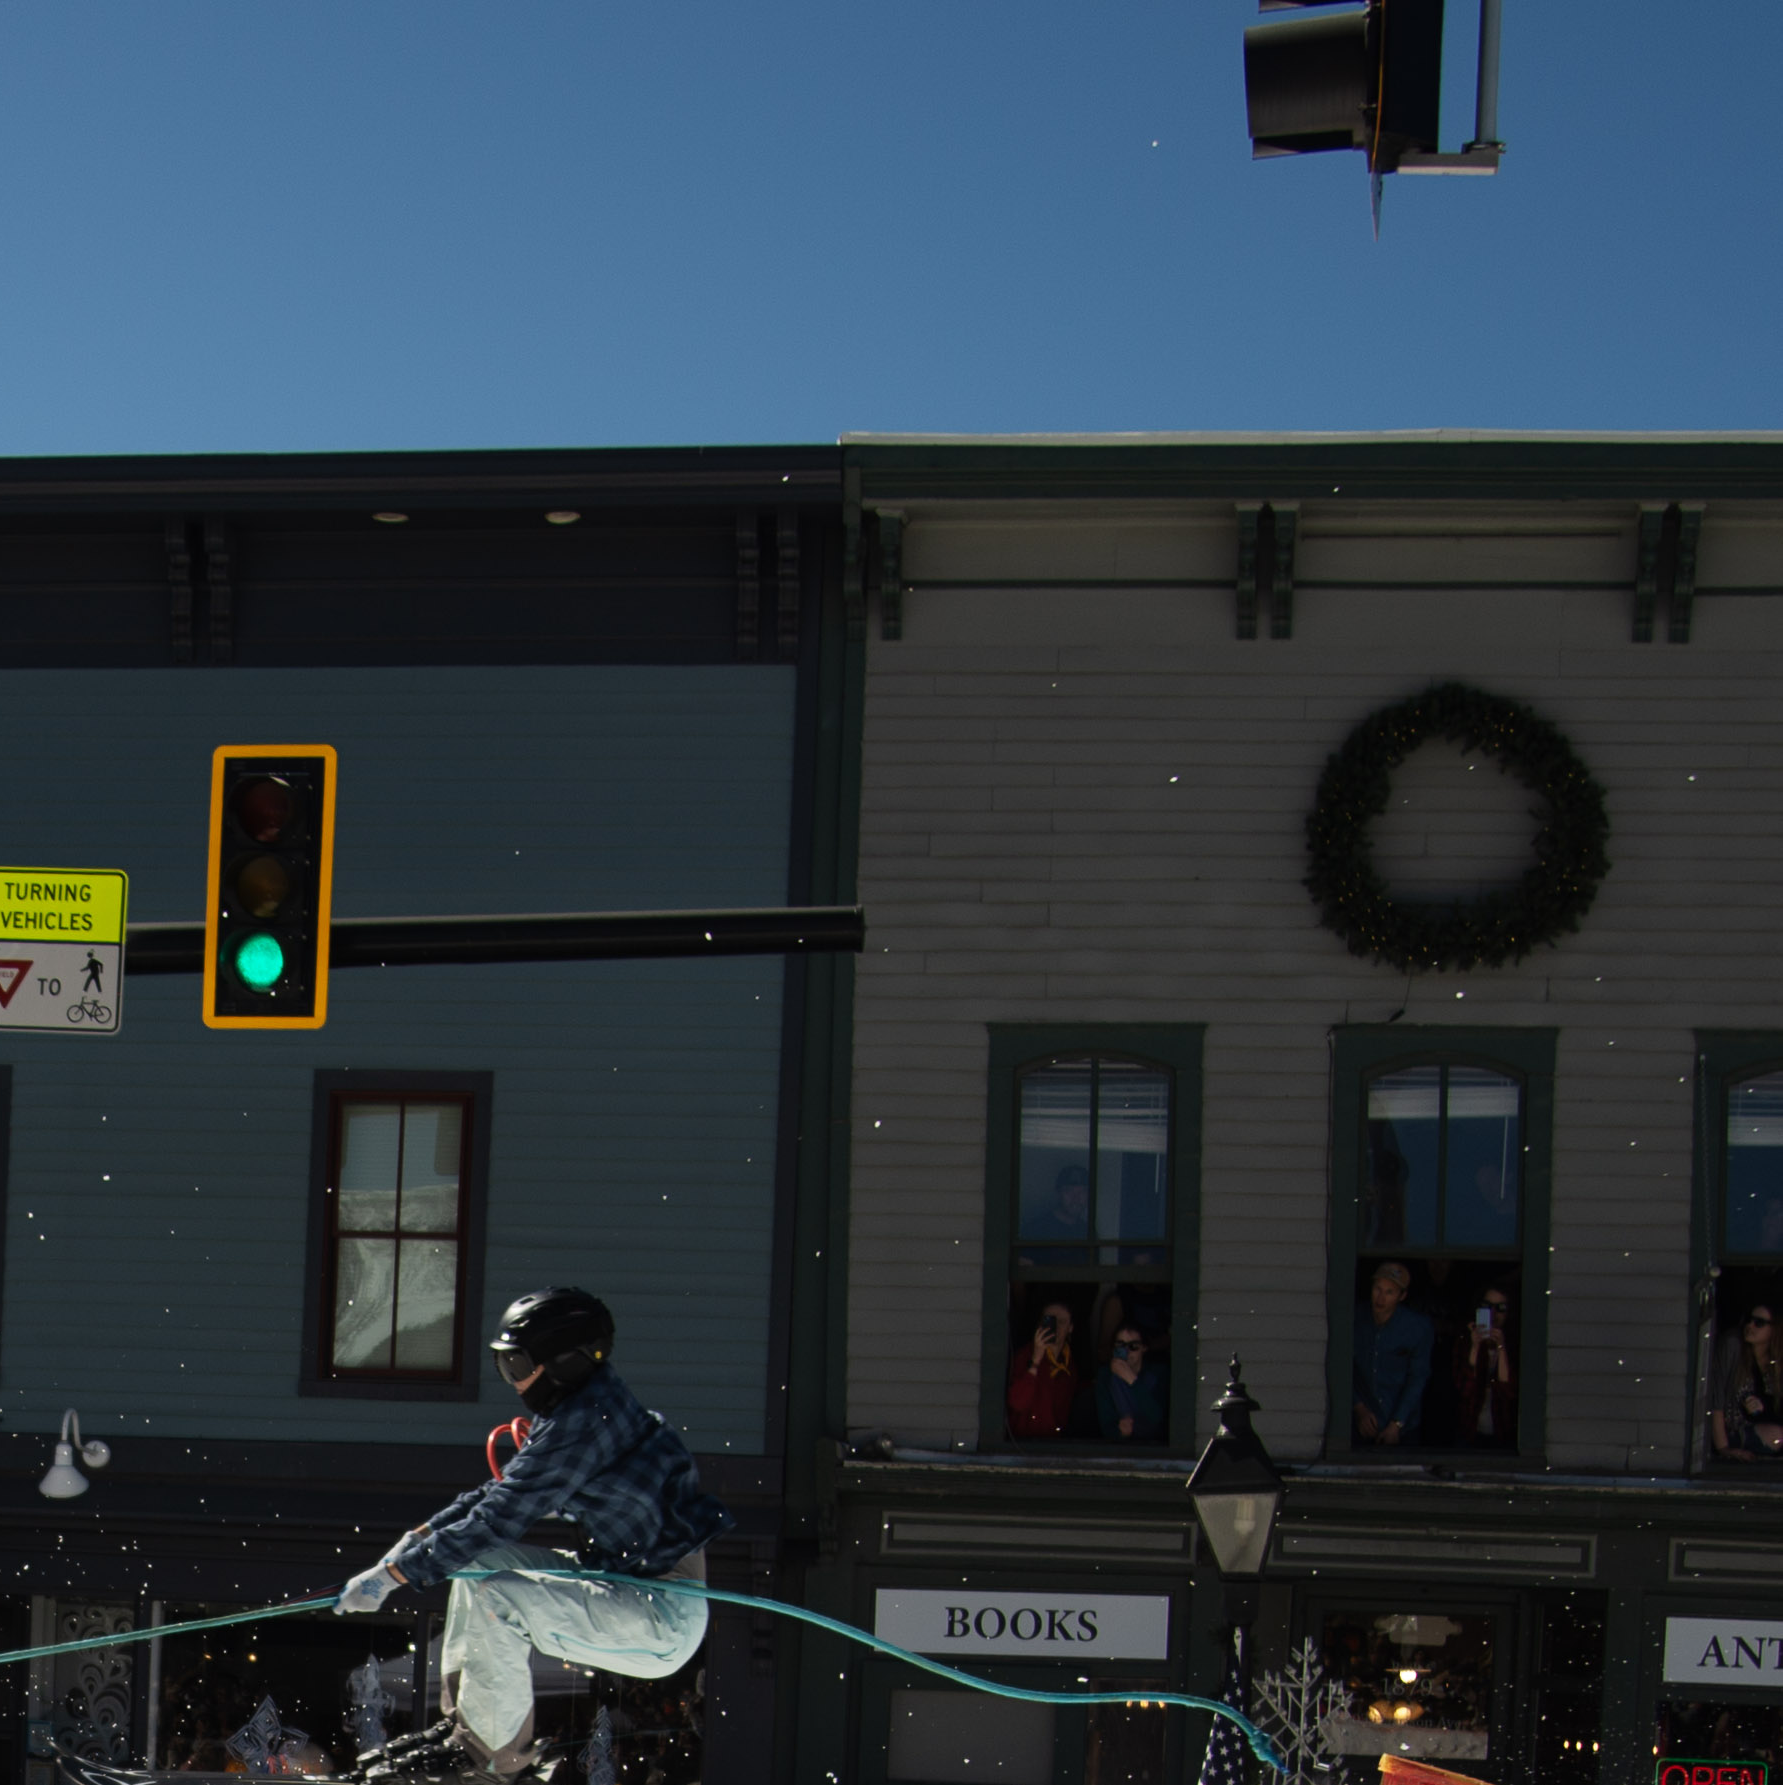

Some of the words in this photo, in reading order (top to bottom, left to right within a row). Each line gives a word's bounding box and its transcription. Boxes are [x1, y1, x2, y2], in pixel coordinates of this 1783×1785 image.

[5, 882, 92, 902] TURNING
[0, 911, 94, 931] VEHICLES
[37, 978, 62, 996] TO
[944, 1607, 1098, 1642] BOOKS
